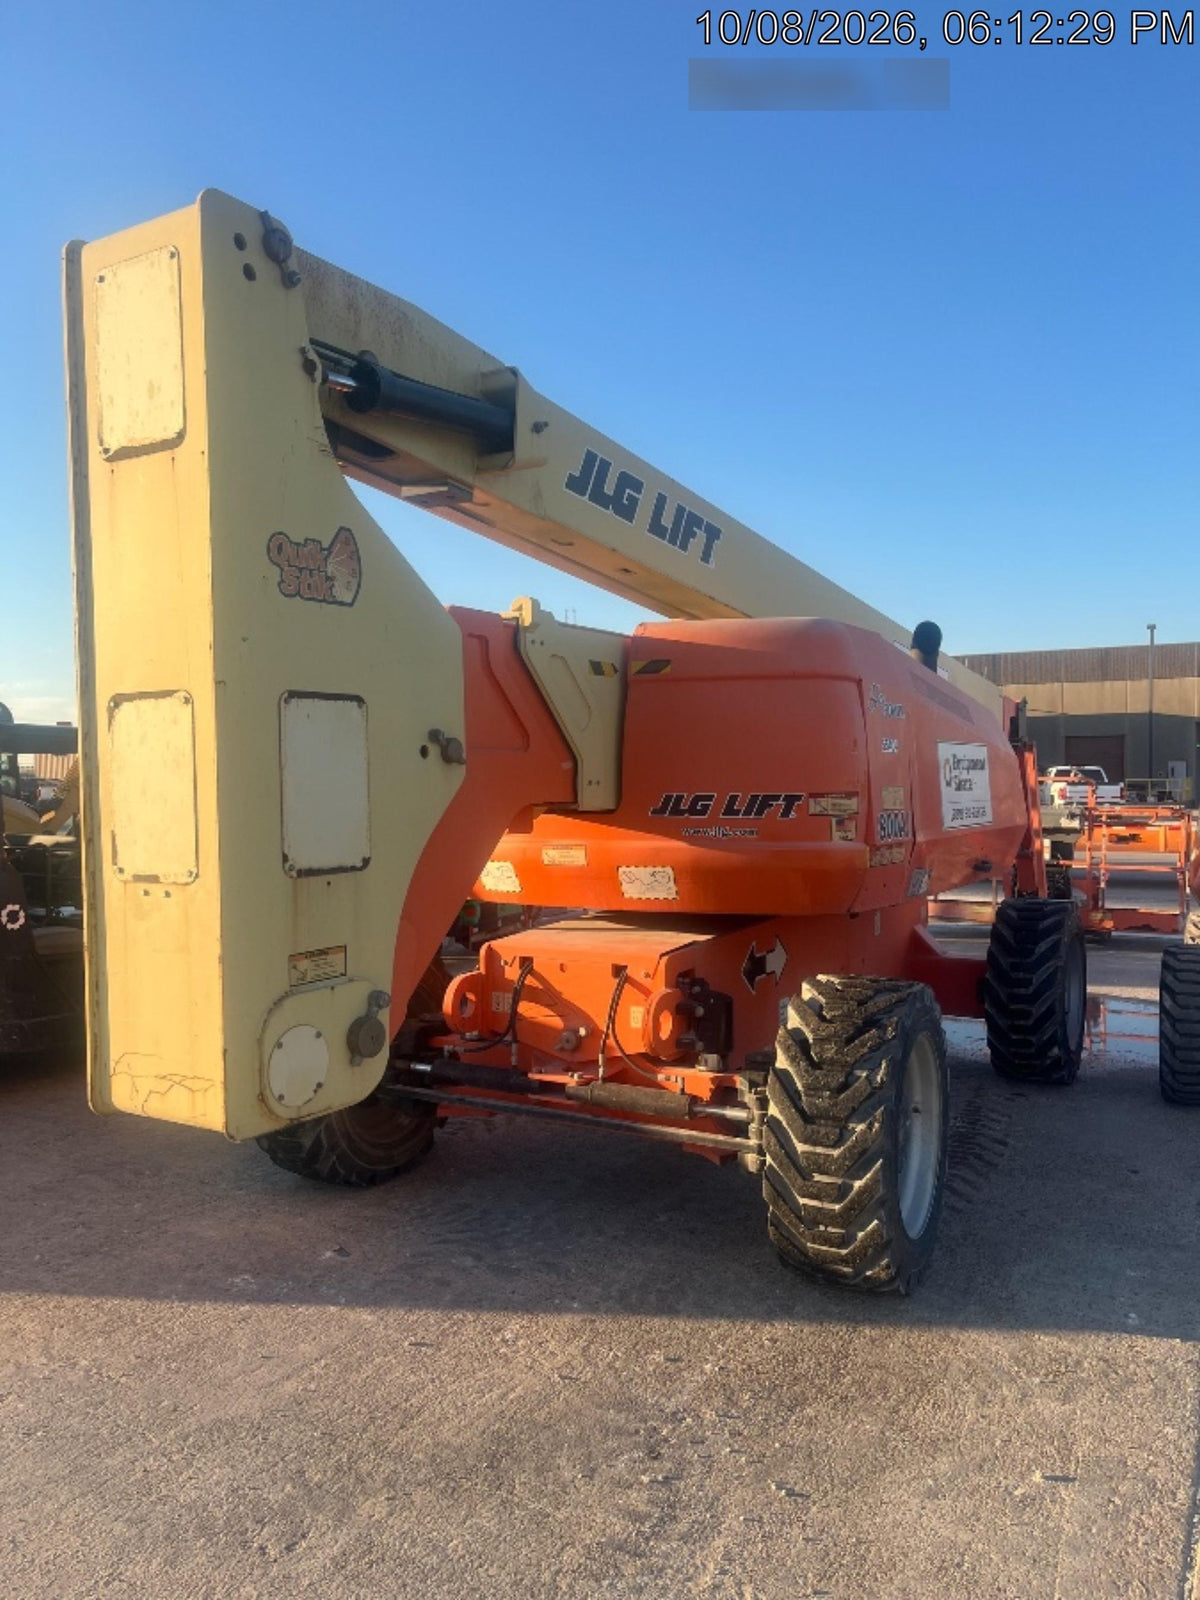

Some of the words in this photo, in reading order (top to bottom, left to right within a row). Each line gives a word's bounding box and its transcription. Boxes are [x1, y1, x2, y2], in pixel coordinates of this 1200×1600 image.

[564, 448, 645, 527] JLG
[646, 491, 723, 569] LIFT
[649, 792, 717, 818] JLG
[719, 792, 806, 819] LIFT
[682, 825, 759, 839] www.jlg.com
